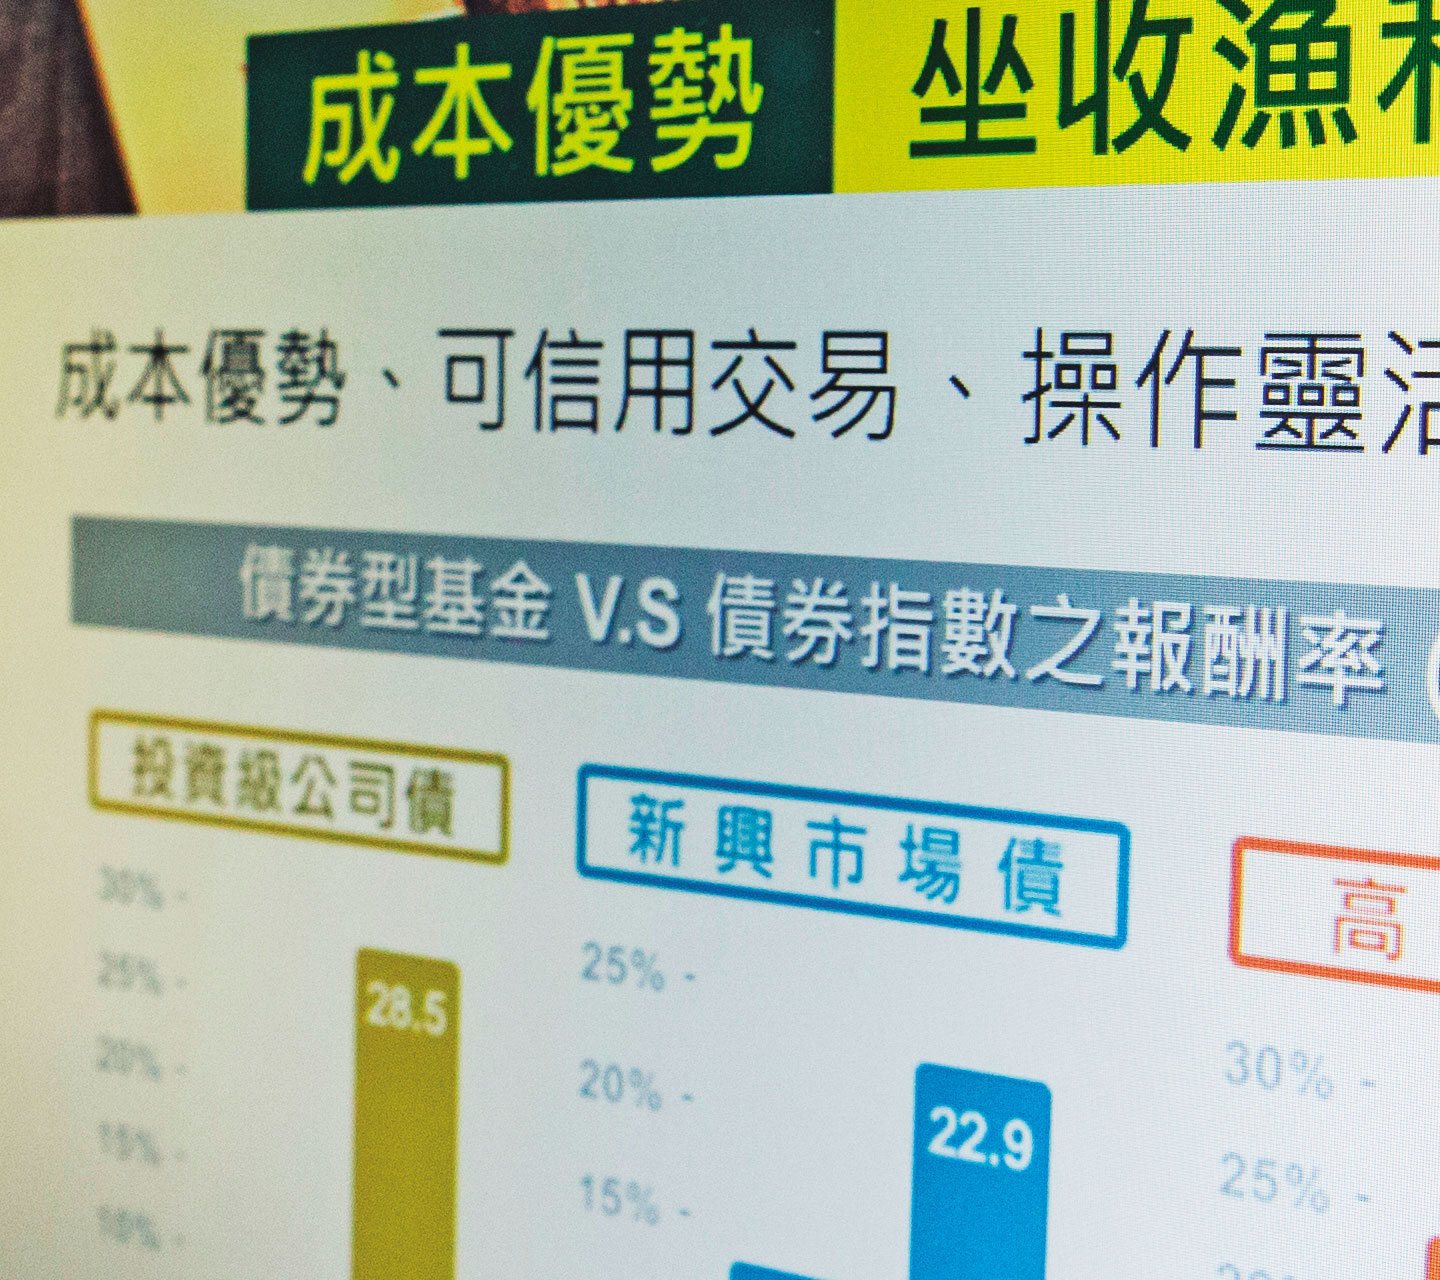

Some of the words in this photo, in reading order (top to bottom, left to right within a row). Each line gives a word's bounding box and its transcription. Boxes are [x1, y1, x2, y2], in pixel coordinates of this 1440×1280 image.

[302, 23, 762, 188] 成本優勢
[237, 543, 552, 650] 債券型基金
[130, 736, 457, 838] 投資級公司債
[628, 792, 1065, 919] 新興市場債
[581, 941, 665, 993] 25%
[364, 979, 448, 1037] 28.5
[578, 1058, 662, 1111] 20%
[1222, 1040, 1336, 1100] 30%
[927, 1104, 1035, 1171] 22.9
[578, 1173, 660, 1228] 15%
[1218, 1153, 1331, 1215] 25%
